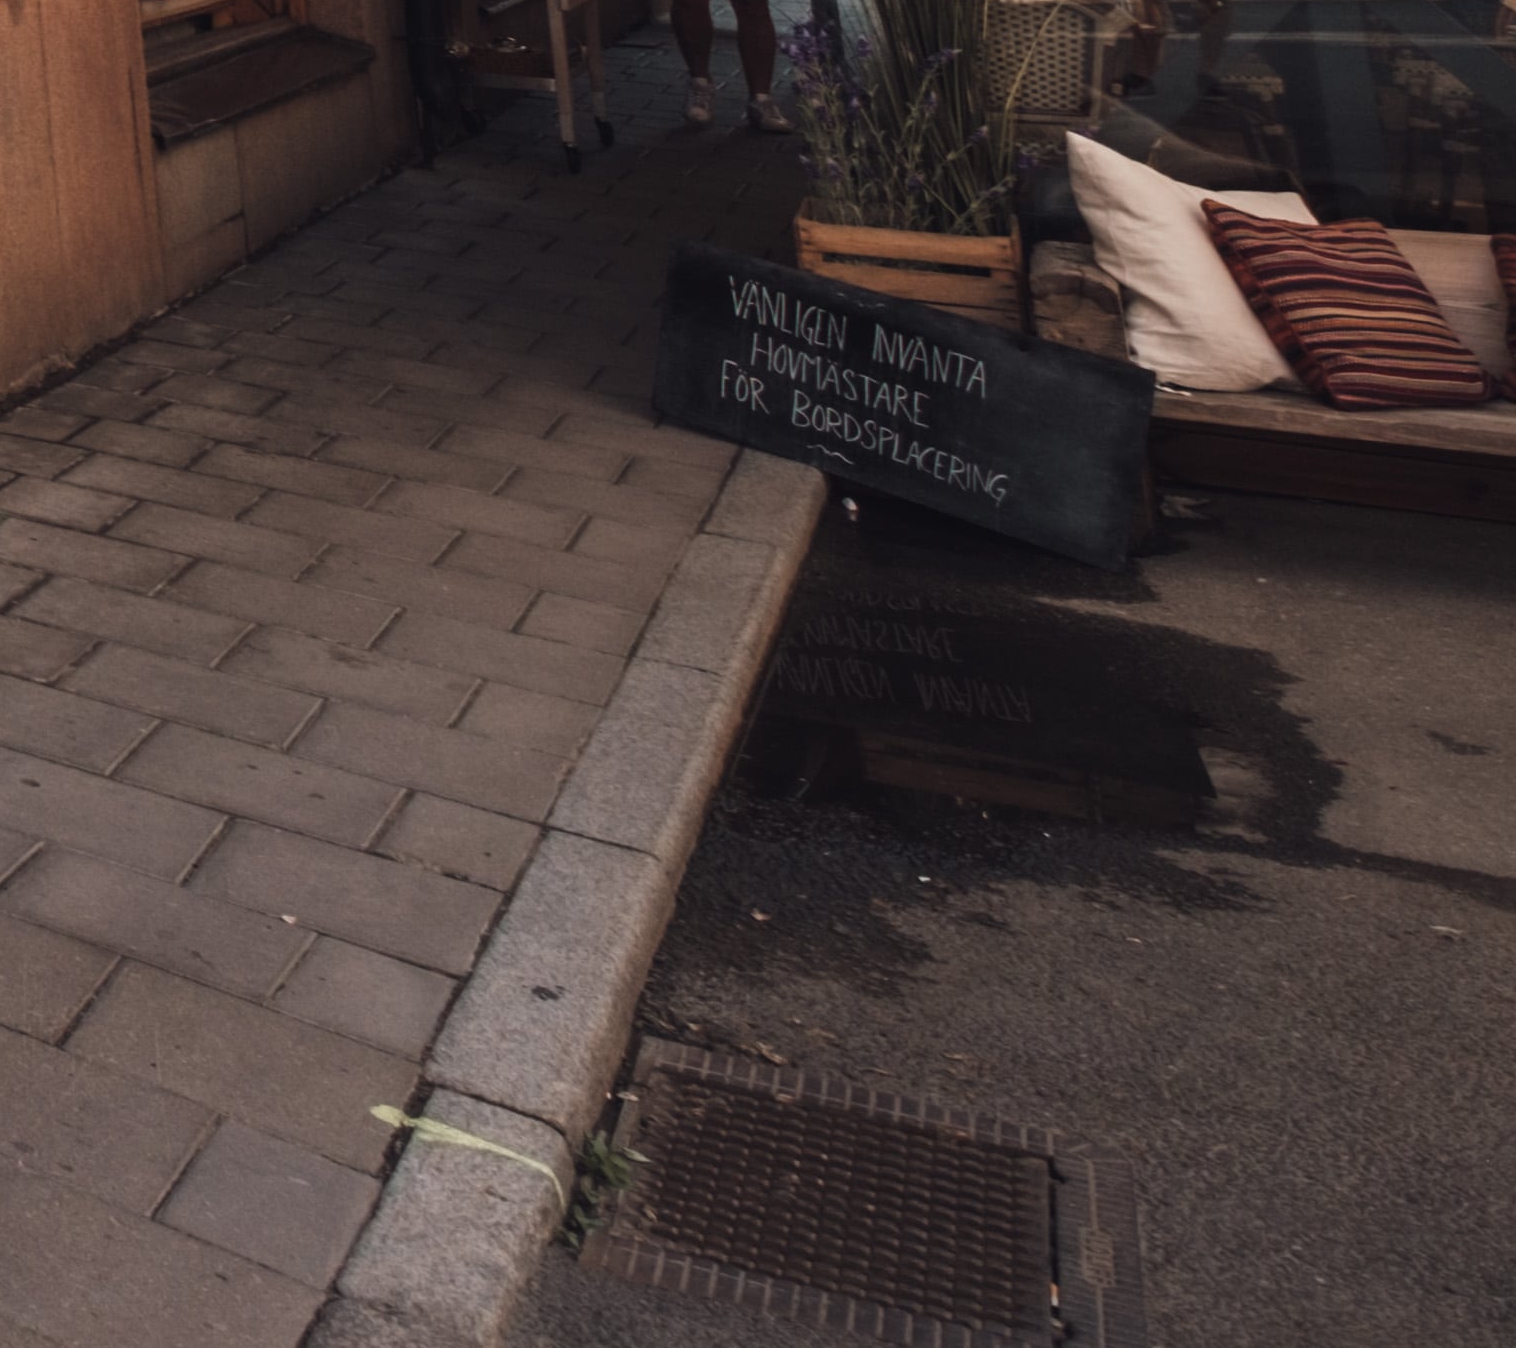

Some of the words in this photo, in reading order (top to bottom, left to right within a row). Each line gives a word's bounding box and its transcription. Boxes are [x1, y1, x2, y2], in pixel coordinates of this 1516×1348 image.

[729, 275, 848, 351] VÄNLIGEN
[751, 332, 931, 429] HOVMÄSTARE
[720, 360, 770, 415] FÖR
[791, 389, 1010, 507] BORDSPLACERING
